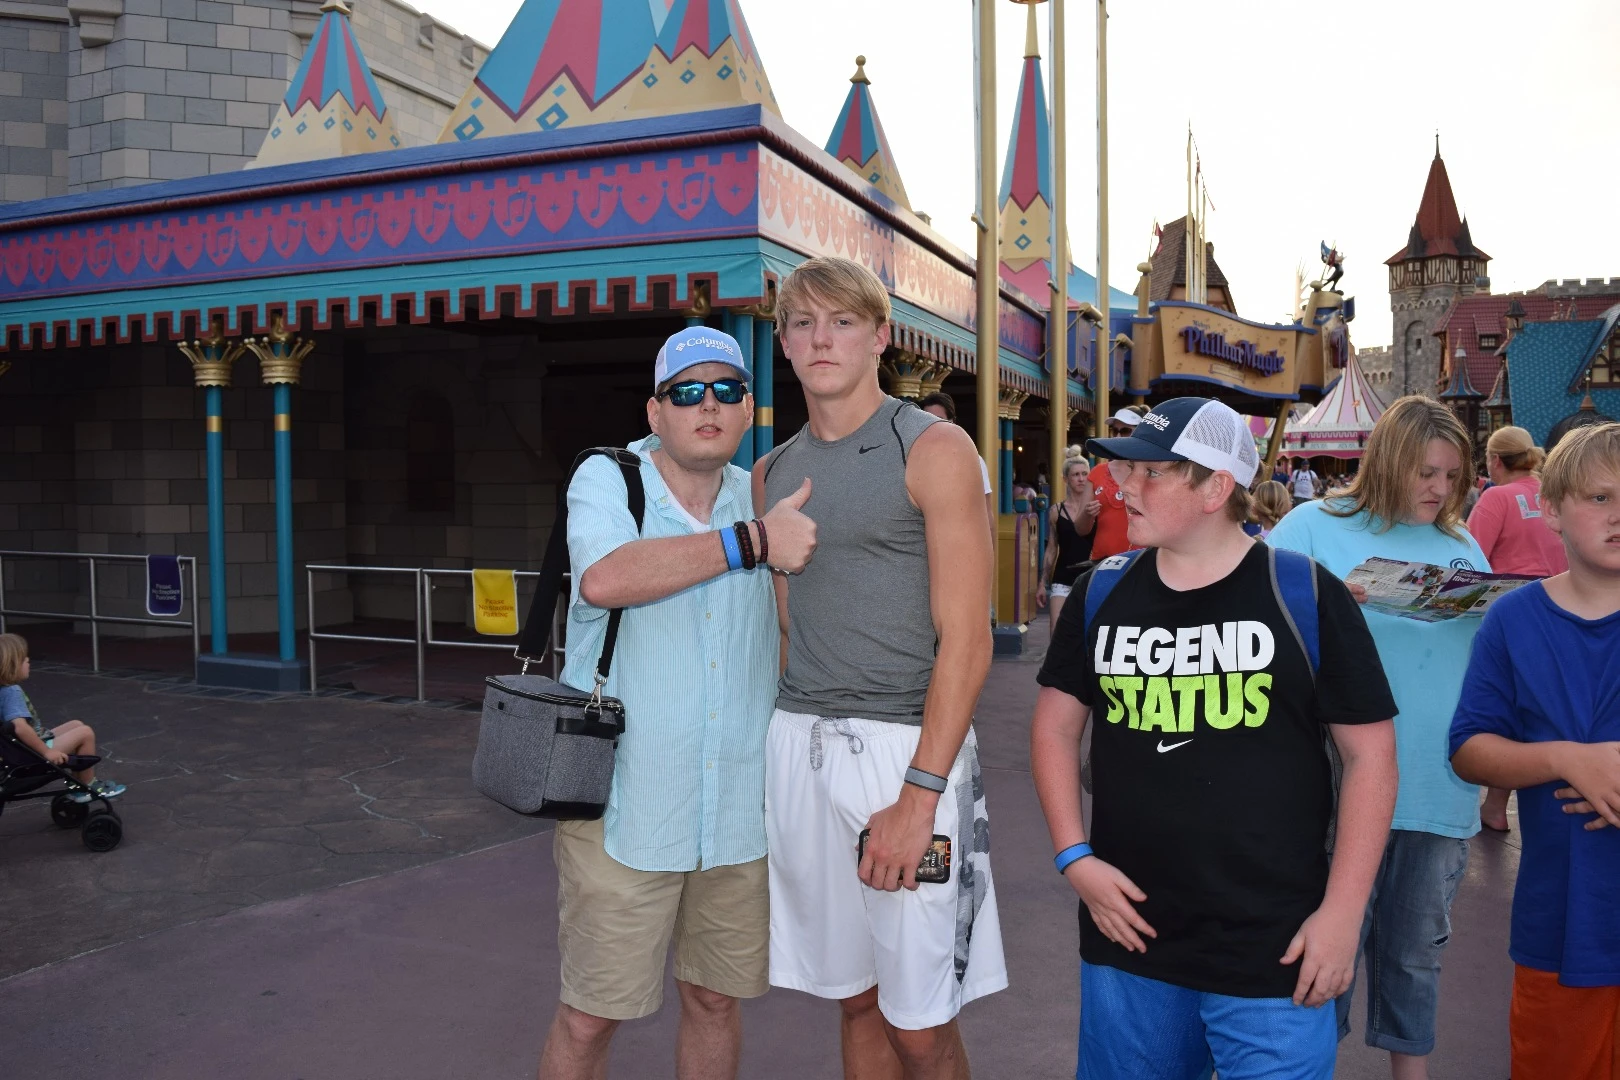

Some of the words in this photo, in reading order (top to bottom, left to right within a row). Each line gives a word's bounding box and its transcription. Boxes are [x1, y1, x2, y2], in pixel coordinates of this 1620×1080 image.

[687, 336, 734, 353] Columbia
[1094, 620, 1275, 676] LEGEND
[1099, 672, 1273, 732] STATUS
